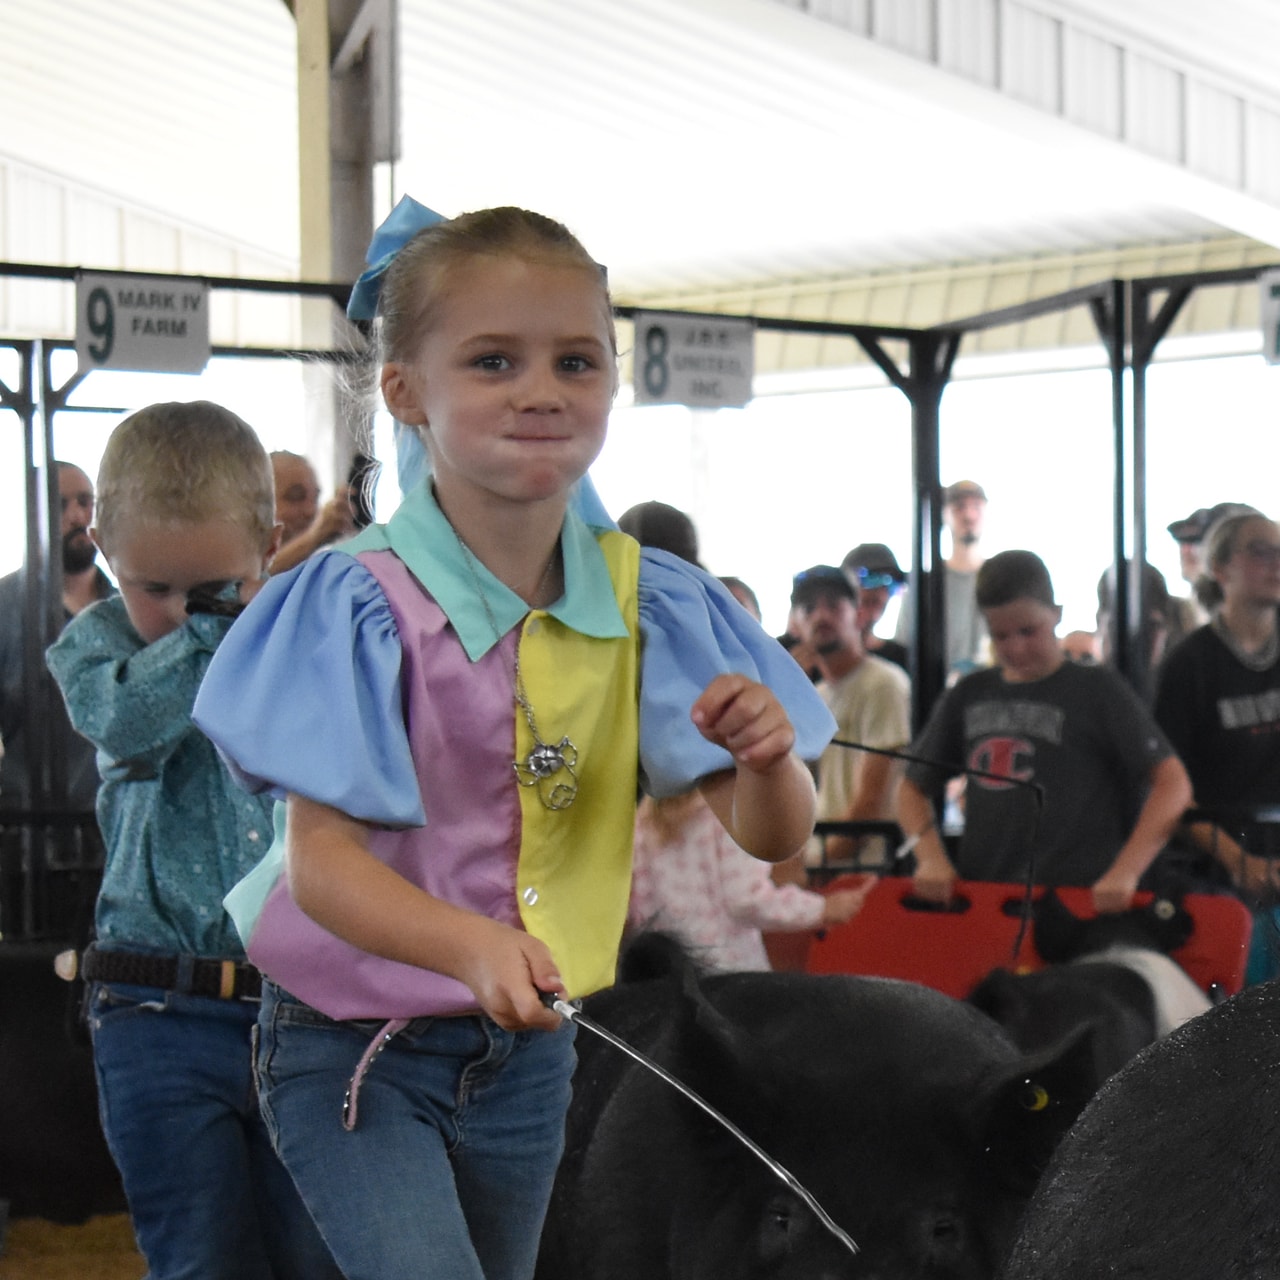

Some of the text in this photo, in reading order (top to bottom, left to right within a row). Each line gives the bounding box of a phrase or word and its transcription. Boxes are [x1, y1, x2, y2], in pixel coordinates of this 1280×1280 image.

[86, 284, 115, 366] 9
[117, 288, 202, 312] MARK IV
[131, 315, 188, 337] FARM
[644, 323, 669, 399] 8
